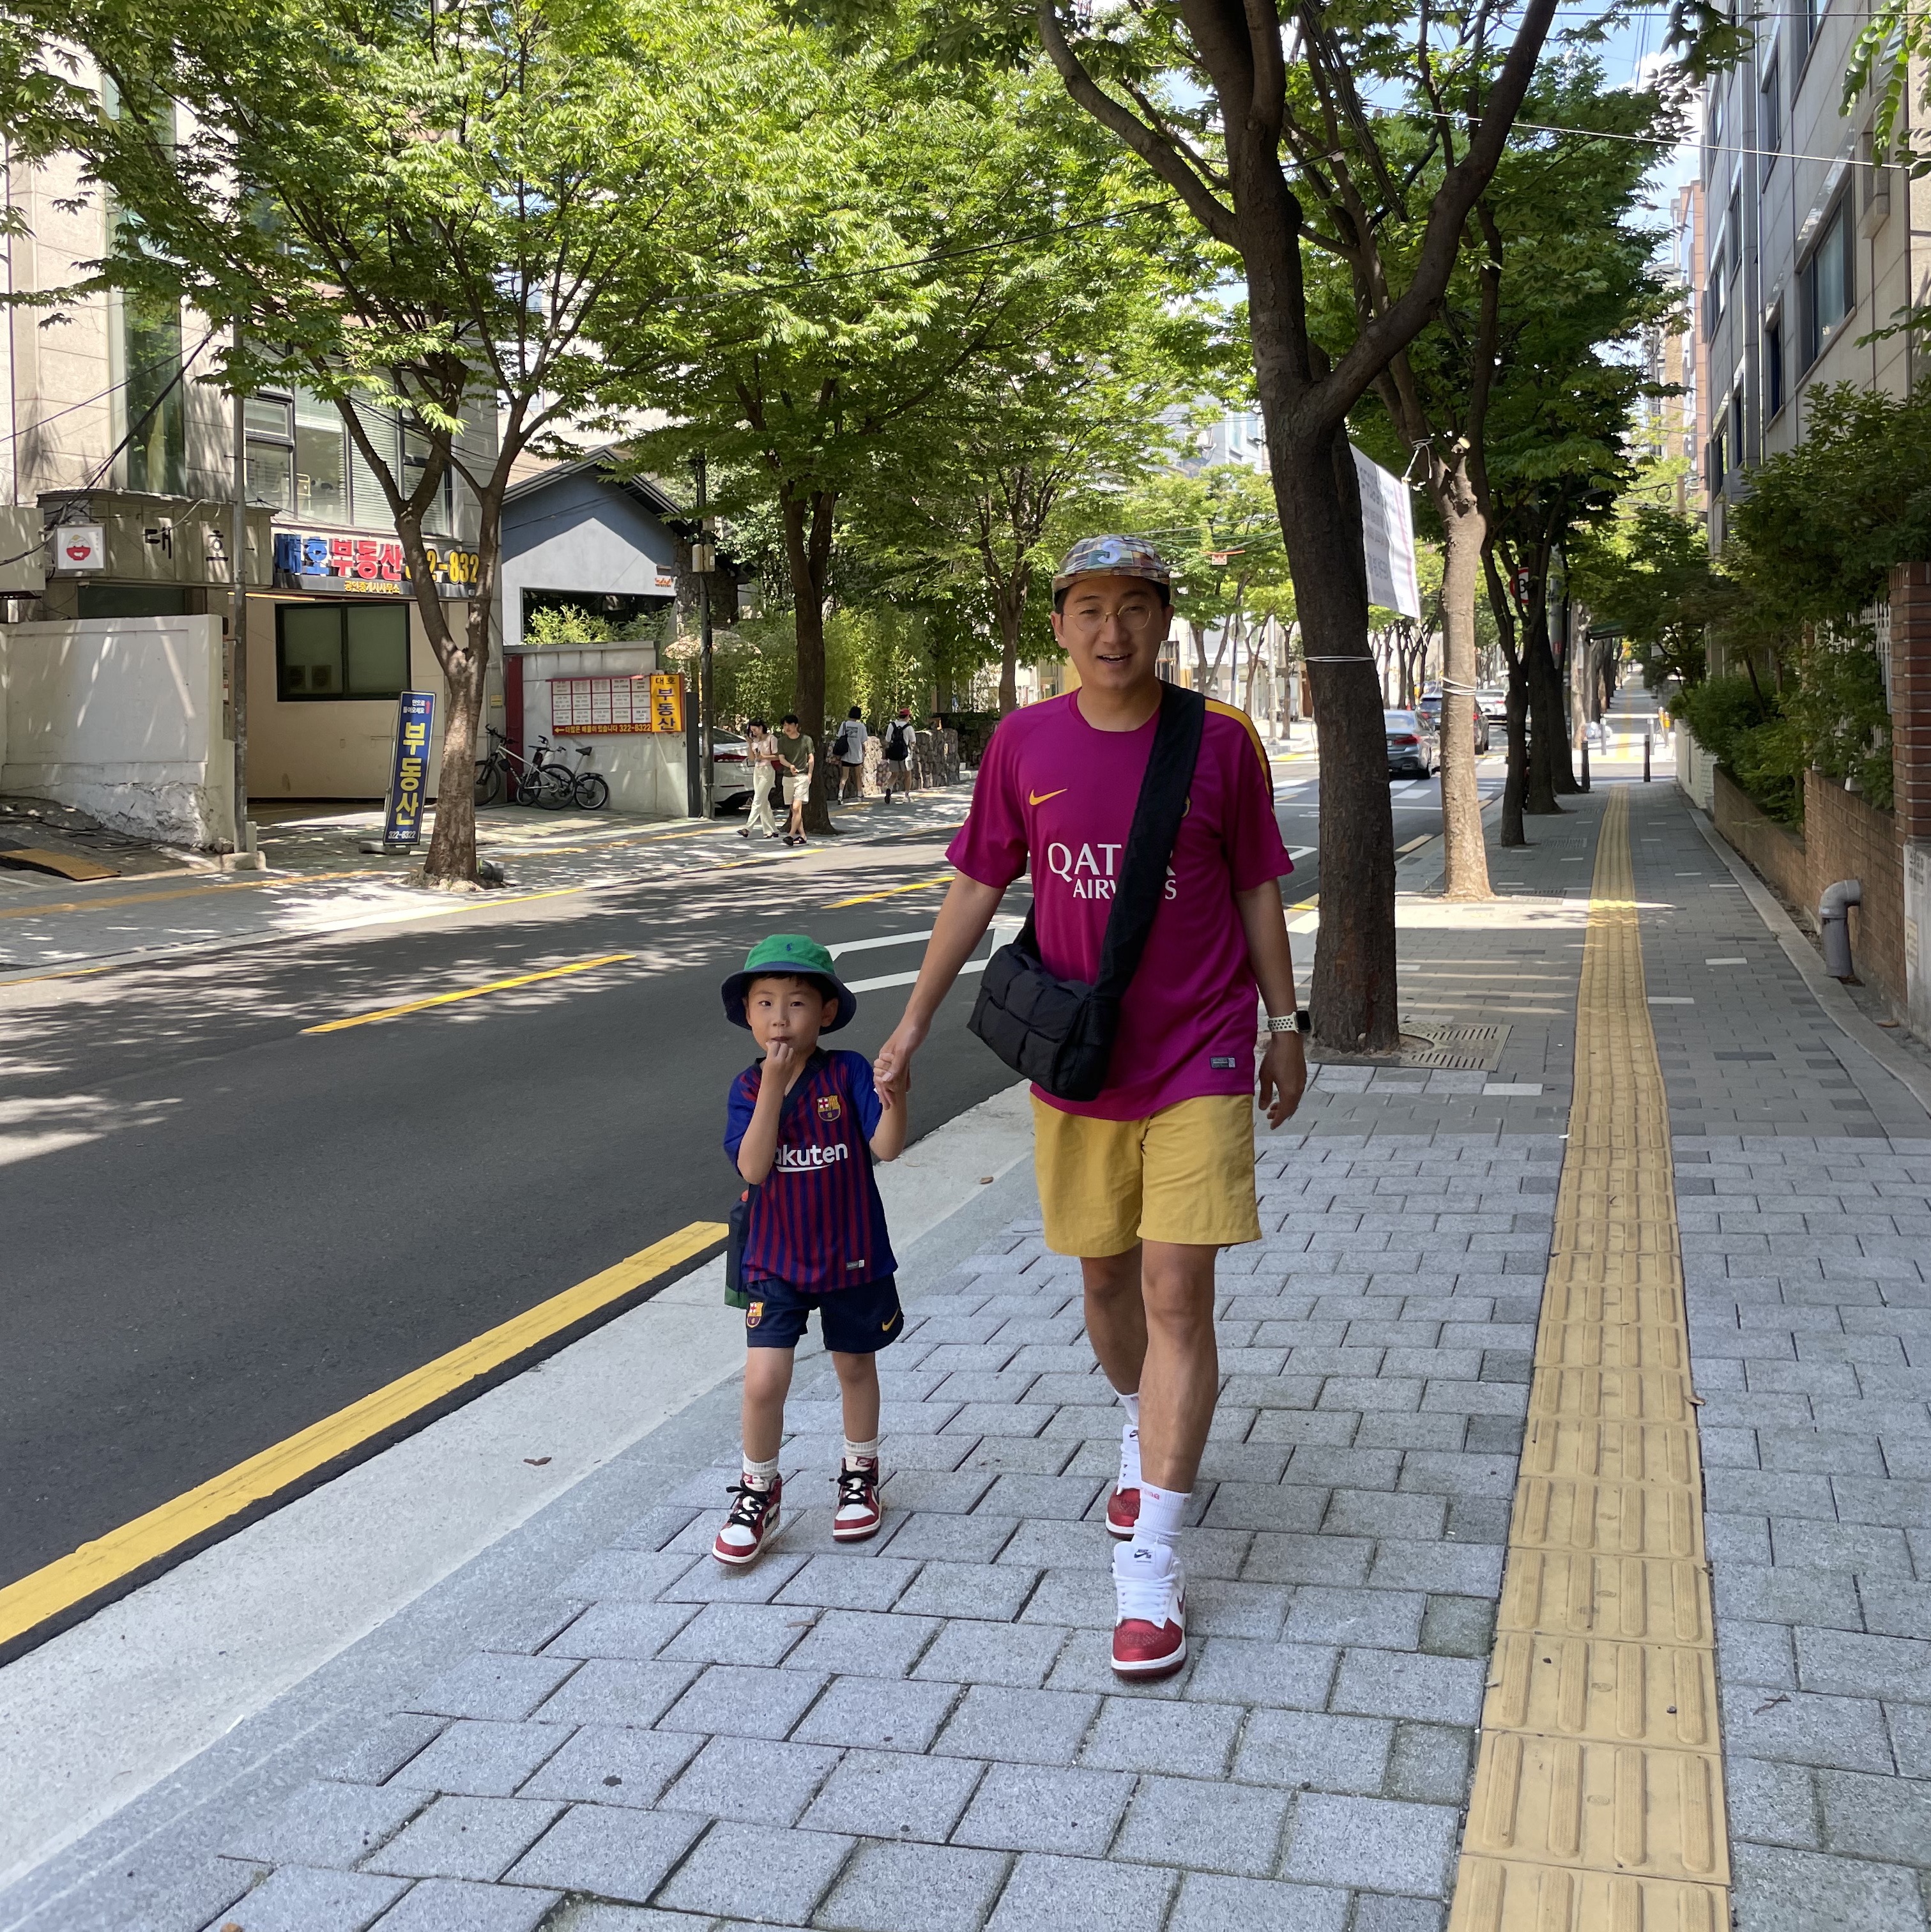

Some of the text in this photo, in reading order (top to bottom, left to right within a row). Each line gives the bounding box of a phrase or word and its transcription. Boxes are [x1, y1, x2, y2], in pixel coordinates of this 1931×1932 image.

[344, 580, 402, 595] 공인중개사사무소
[655, 676, 676, 685] 대호
[656, 688, 676, 730] 부동산
[619, 724, 652, 732] 322-8322
[395, 722, 425, 826] 부동산
[1048, 842, 1176, 882] QAT
[1072, 878, 1177, 900] AIRS
[774, 1143, 848, 1166] akuten
